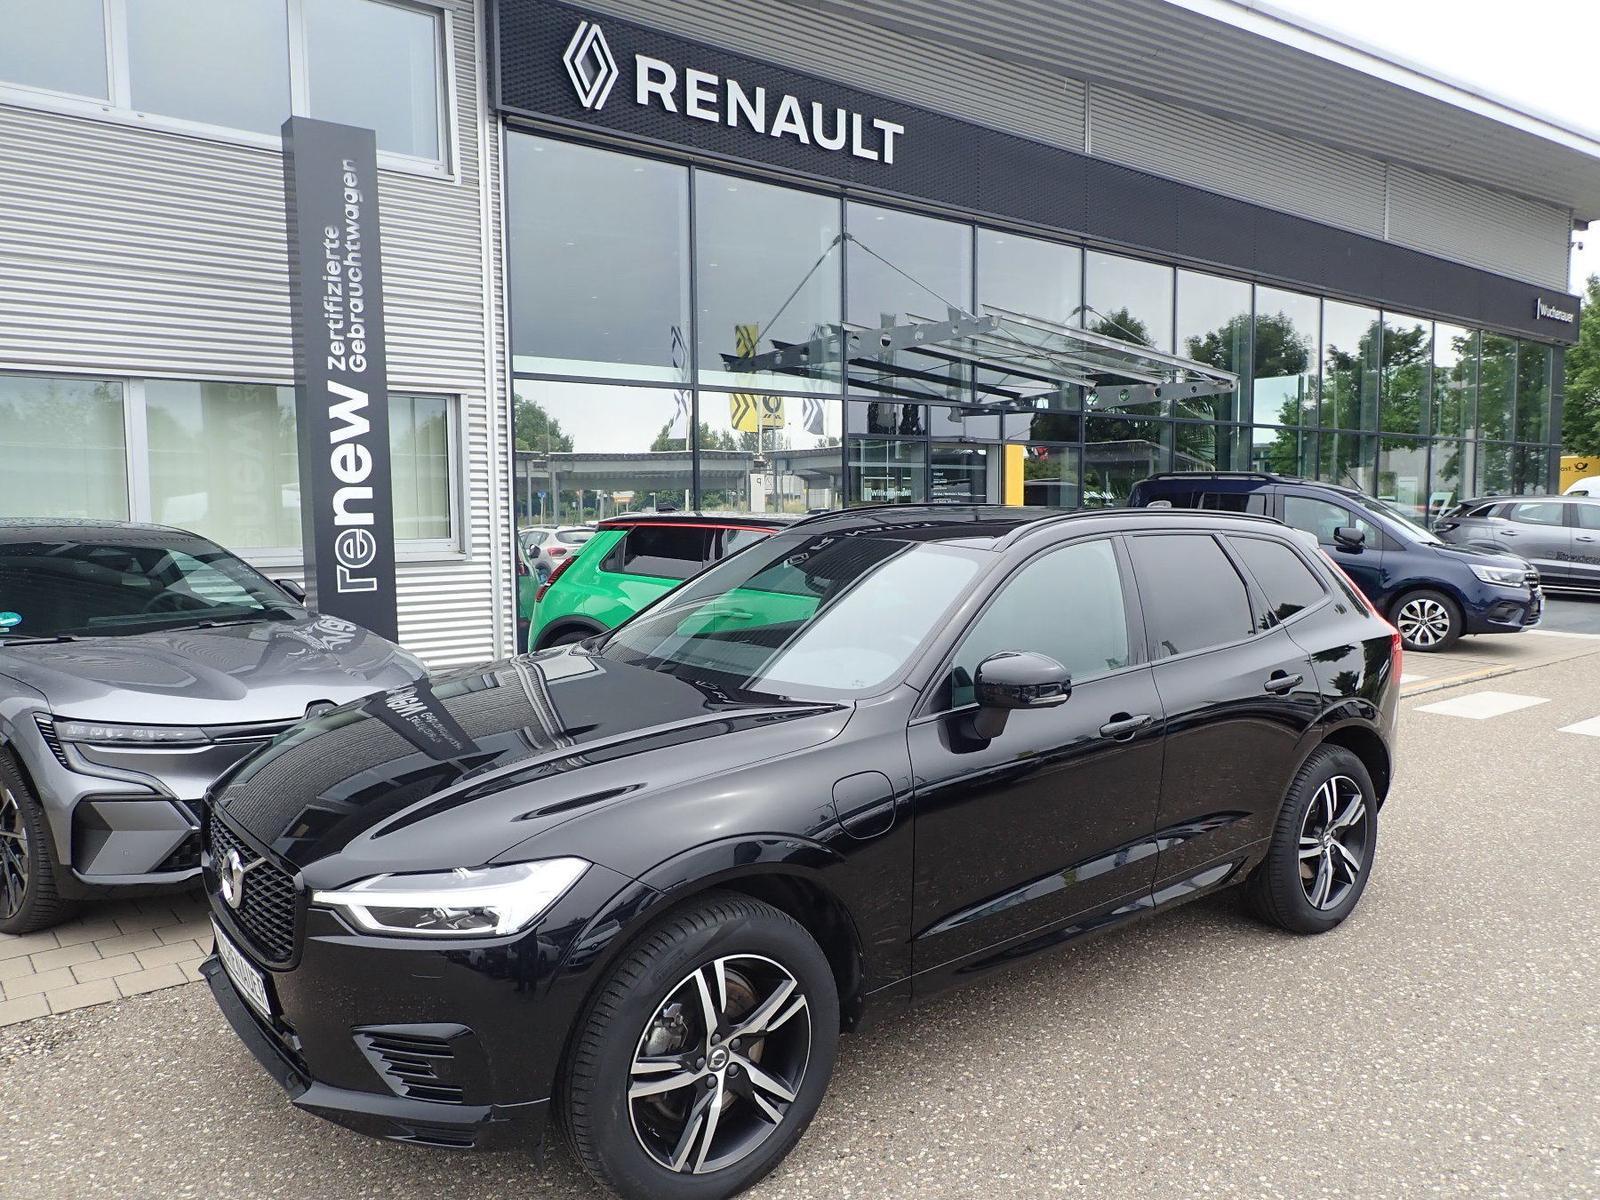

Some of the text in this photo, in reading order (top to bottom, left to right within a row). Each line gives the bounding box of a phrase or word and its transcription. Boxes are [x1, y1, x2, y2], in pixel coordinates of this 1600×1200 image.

[635, 54, 904, 165] RENAULT
[323, 225, 346, 371] Zertifizierte
[343, 159, 368, 373] Gebrauchtwagen
[327, 380, 378, 593] renew
